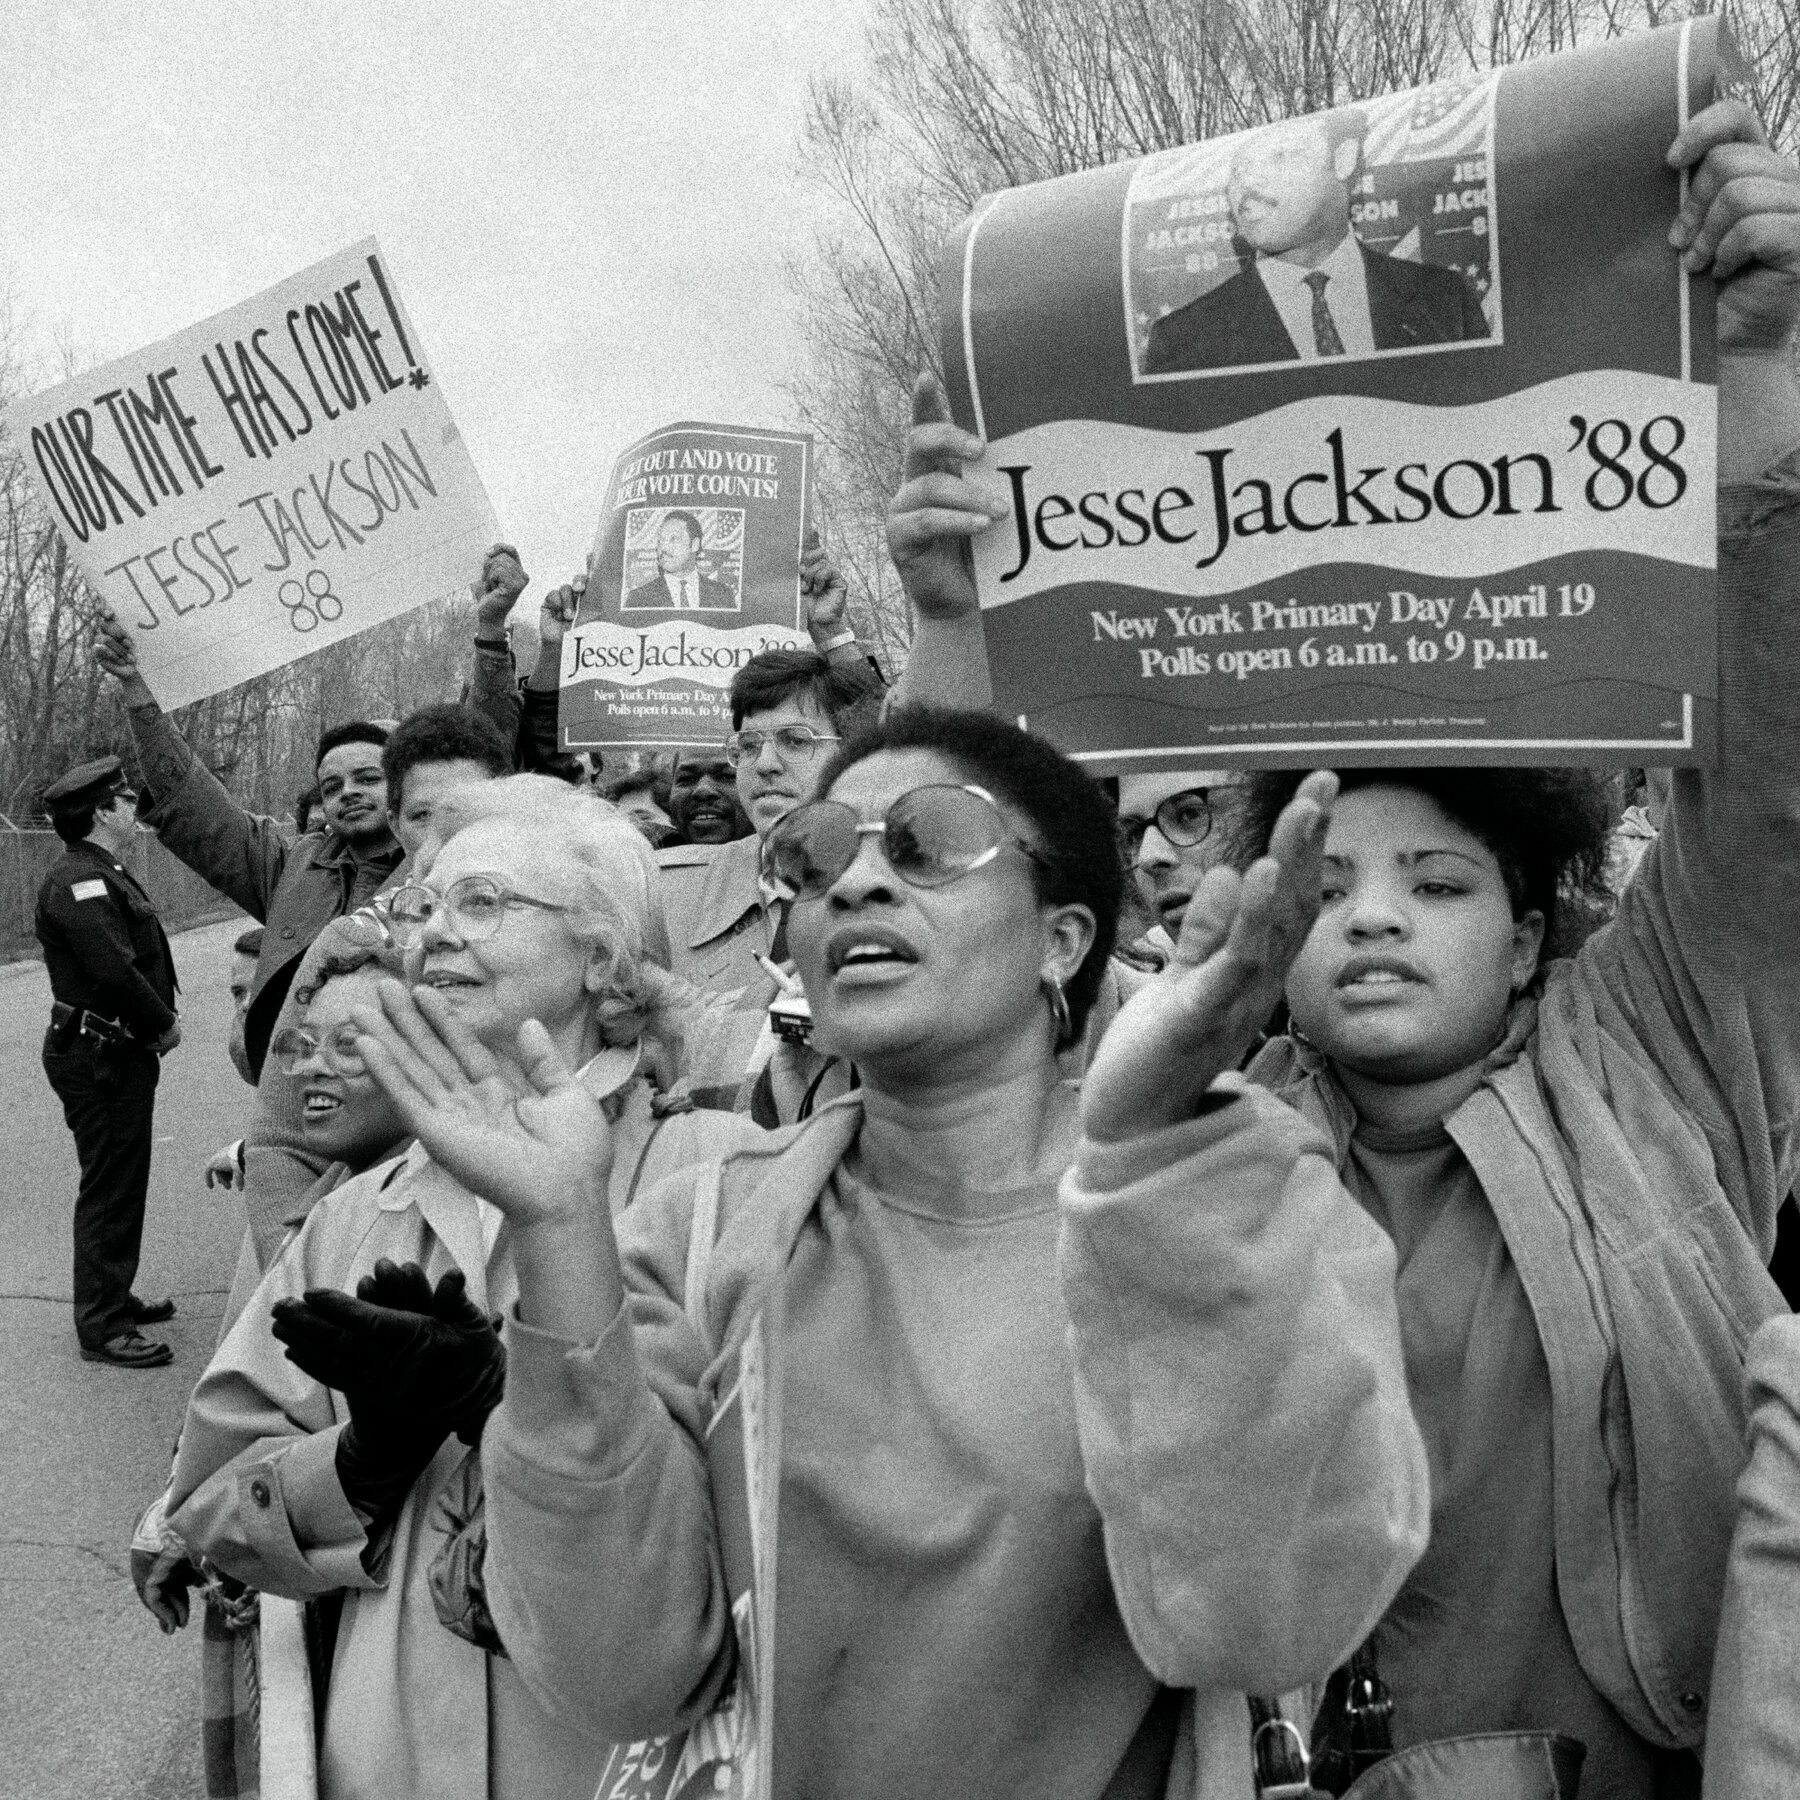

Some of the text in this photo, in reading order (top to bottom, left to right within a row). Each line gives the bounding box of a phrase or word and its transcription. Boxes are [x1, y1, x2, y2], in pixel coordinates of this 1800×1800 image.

[31, 254, 430, 543] OUR TIME HAS COME!
[644, 449, 679, 473] OUT
[680, 448, 723, 470] AND
[725, 451, 778, 475] VOTE
[649, 474, 695, 495] VOTE
[697, 474, 779, 500] COUNTS!
[997, 415, 1687, 582] Jesse Jackson '88
[104, 428, 438, 630] JESSE JACKSON
[278, 569, 343, 632] 88
[1090, 583, 1597, 641] New York Primary Day April 19
[568, 631, 754, 678] Jesse Jackson
[1138, 630, 1549, 680] Polls open 6 a.m. to 9 p.m.
[593, 689, 616, 702] New
[618, 689, 644, 701] York
[646, 689, 691, 703] Primary
[694, 689, 717, 703] Day
[607, 703, 734, 719] Polls open 6 a.m. to 9 p.
